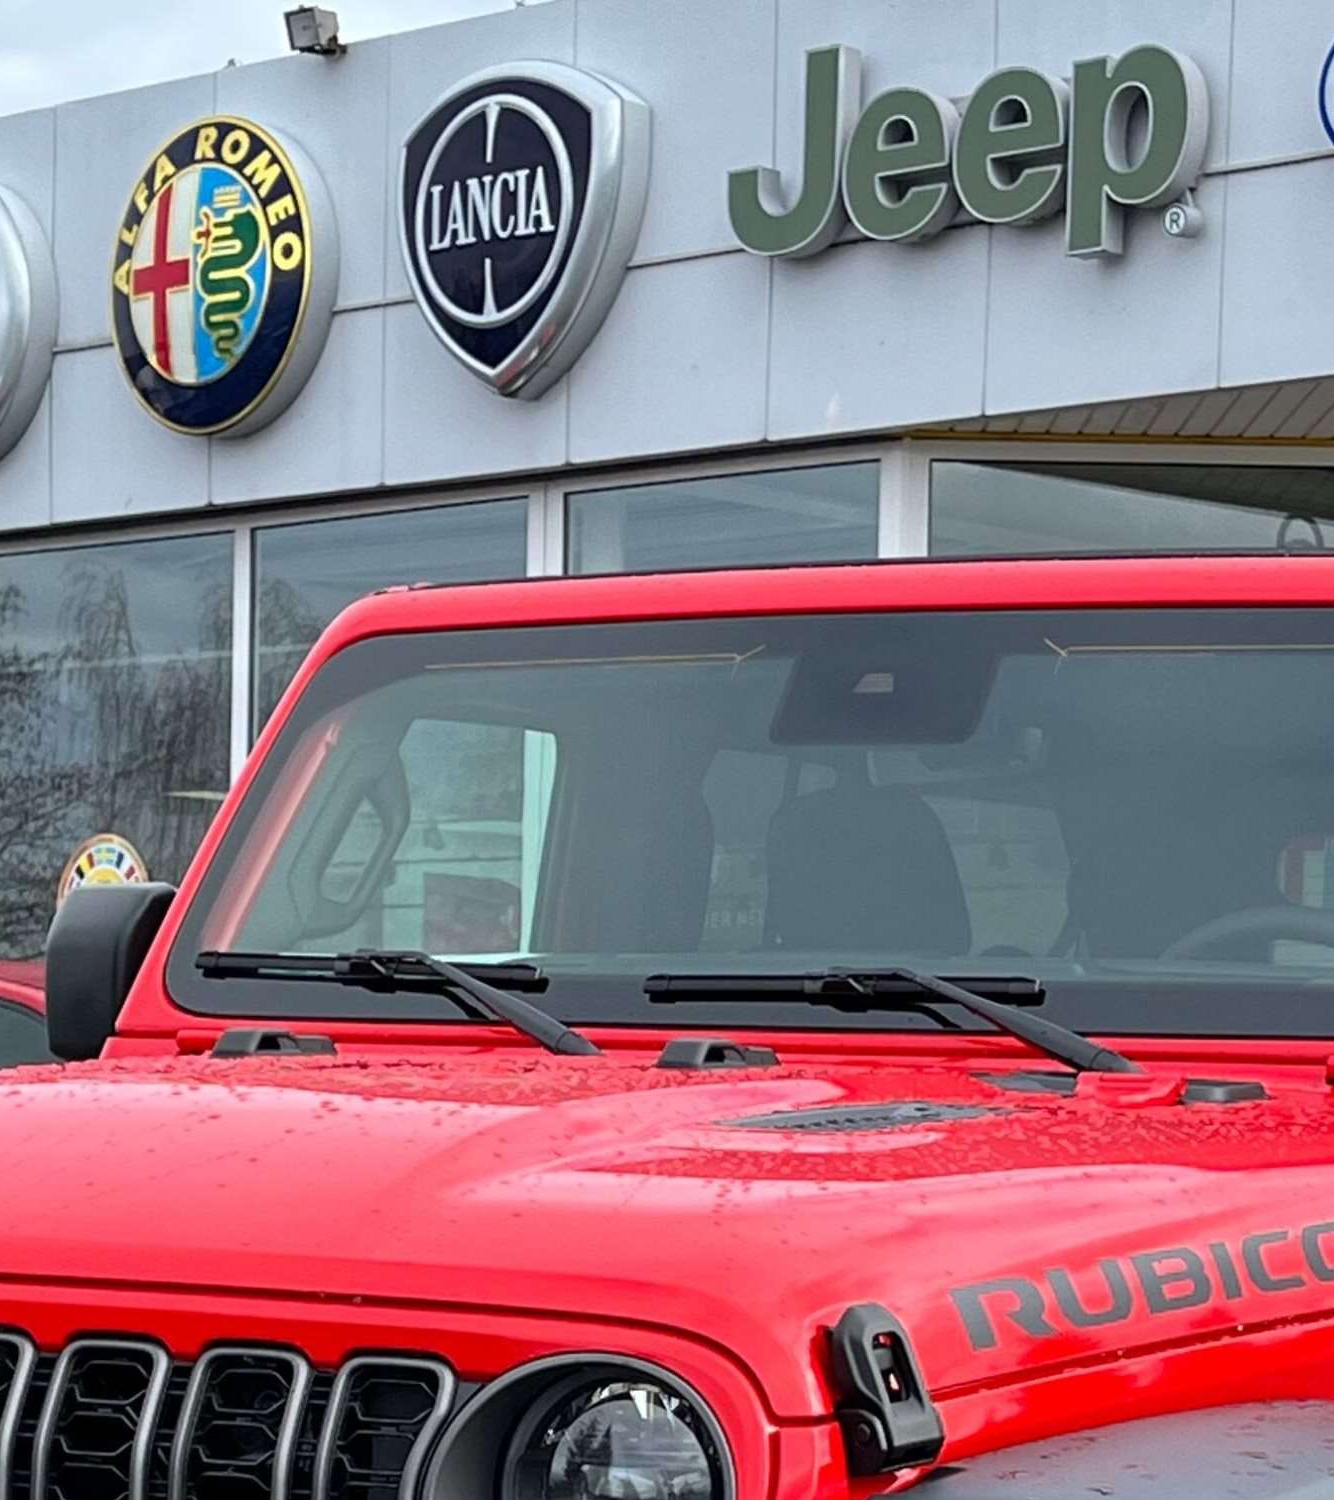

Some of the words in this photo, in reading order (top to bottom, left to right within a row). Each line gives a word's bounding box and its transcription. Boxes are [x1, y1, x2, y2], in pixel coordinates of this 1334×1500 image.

[114, 153, 177, 295] ALFA
[194, 126, 303, 271] ROMEO
[429, 166, 555, 251] LANCIA
[727, 43, 1206, 259] Jeep
